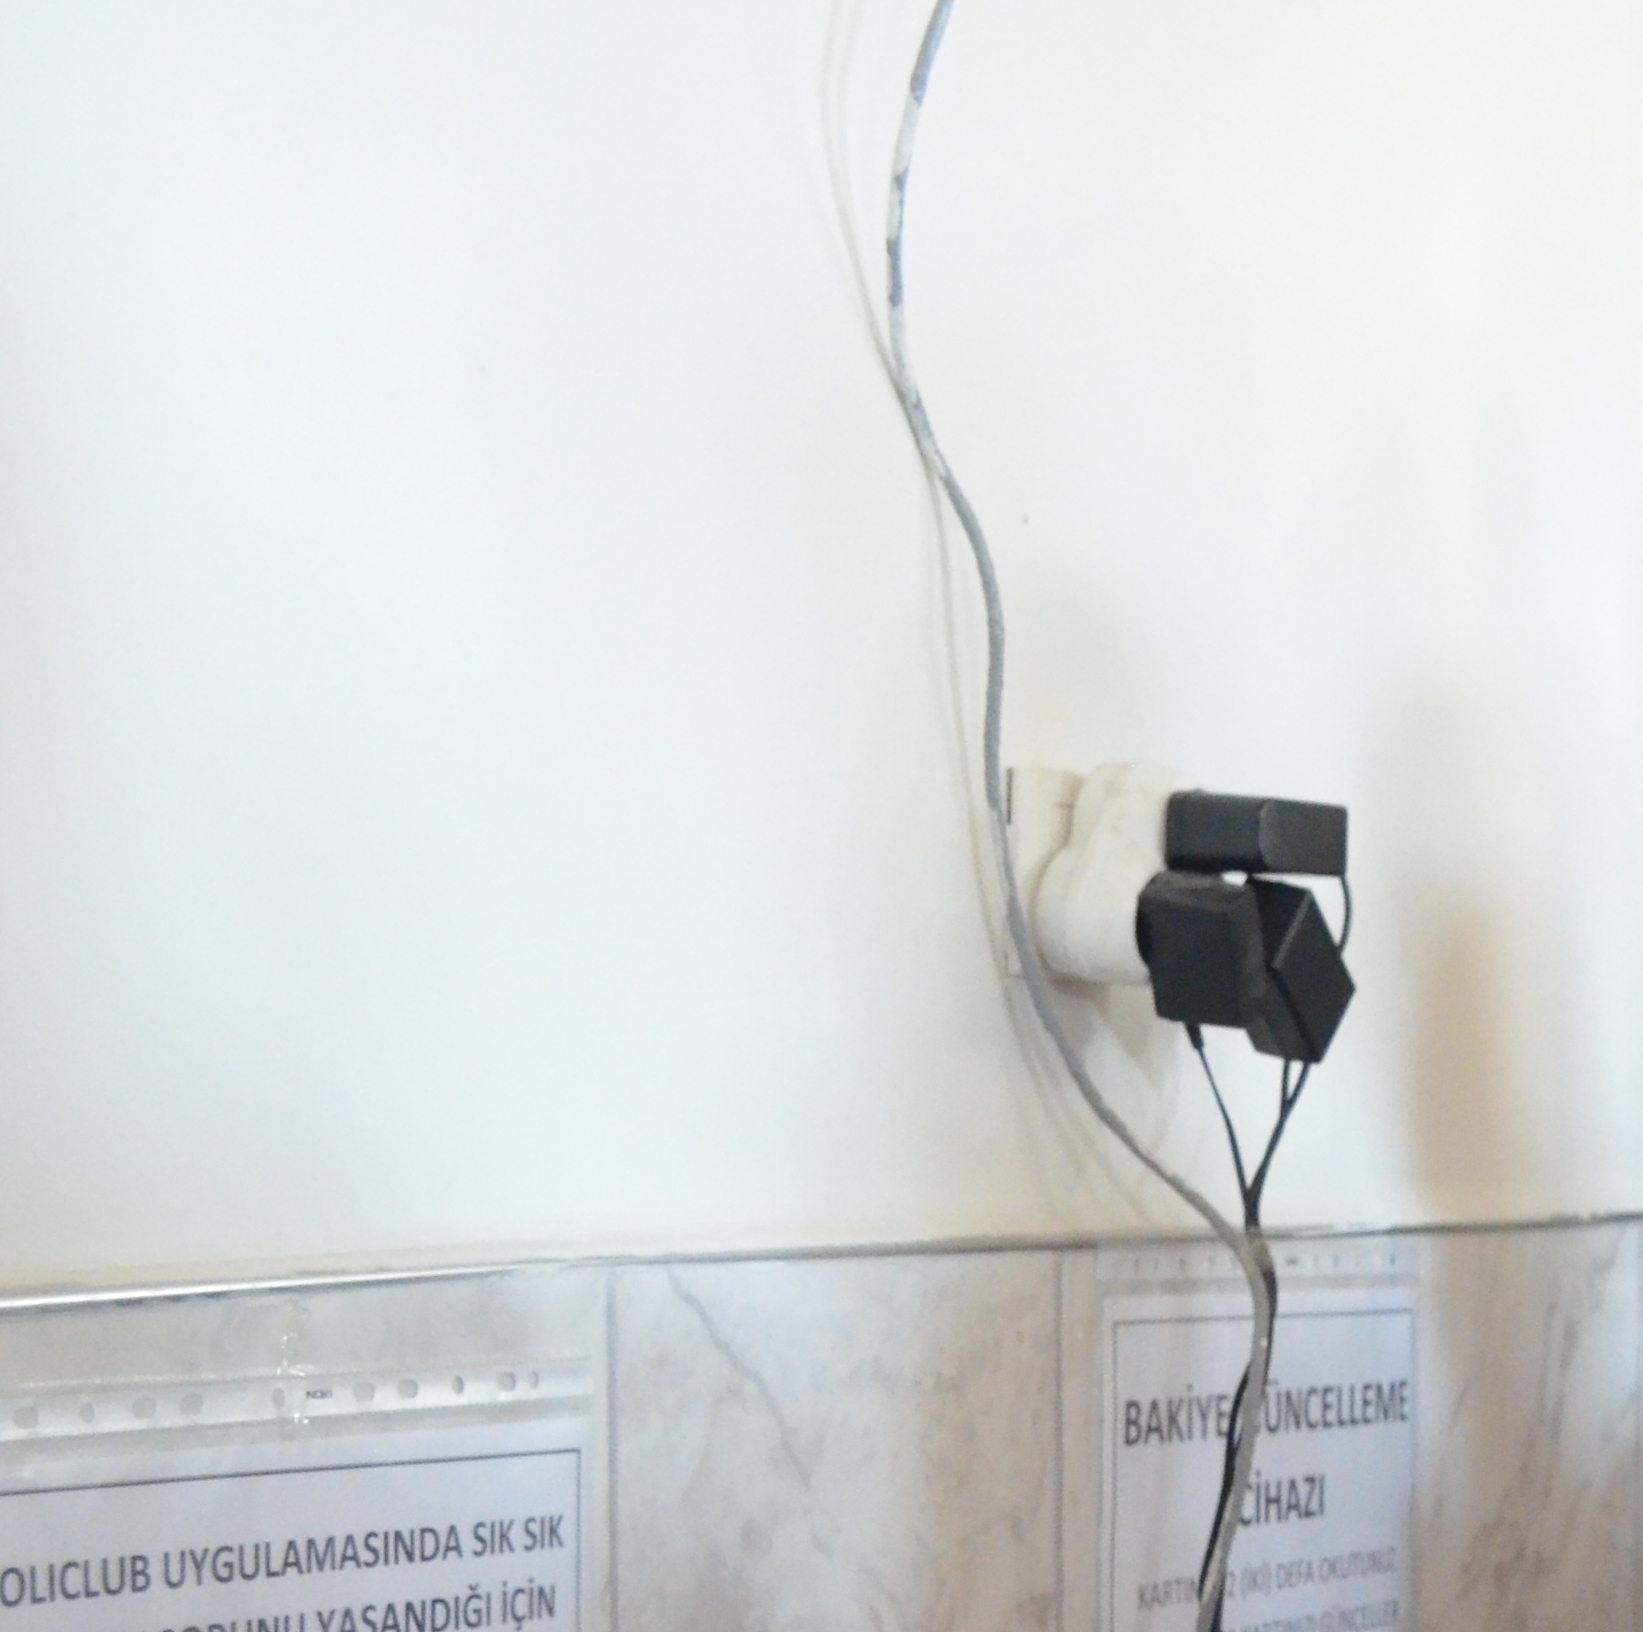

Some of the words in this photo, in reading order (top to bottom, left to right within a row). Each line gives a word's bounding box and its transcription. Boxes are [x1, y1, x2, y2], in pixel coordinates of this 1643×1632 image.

[1264, 1378, 1410, 1434] ÜNCELLEME
[163, 1523, 464, 1589] UYGULAMASINDA
[472, 1518, 516, 1558] SIK
[523, 1513, 565, 1552] SIK
[502, 1577, 556, 1632] İÇİN
